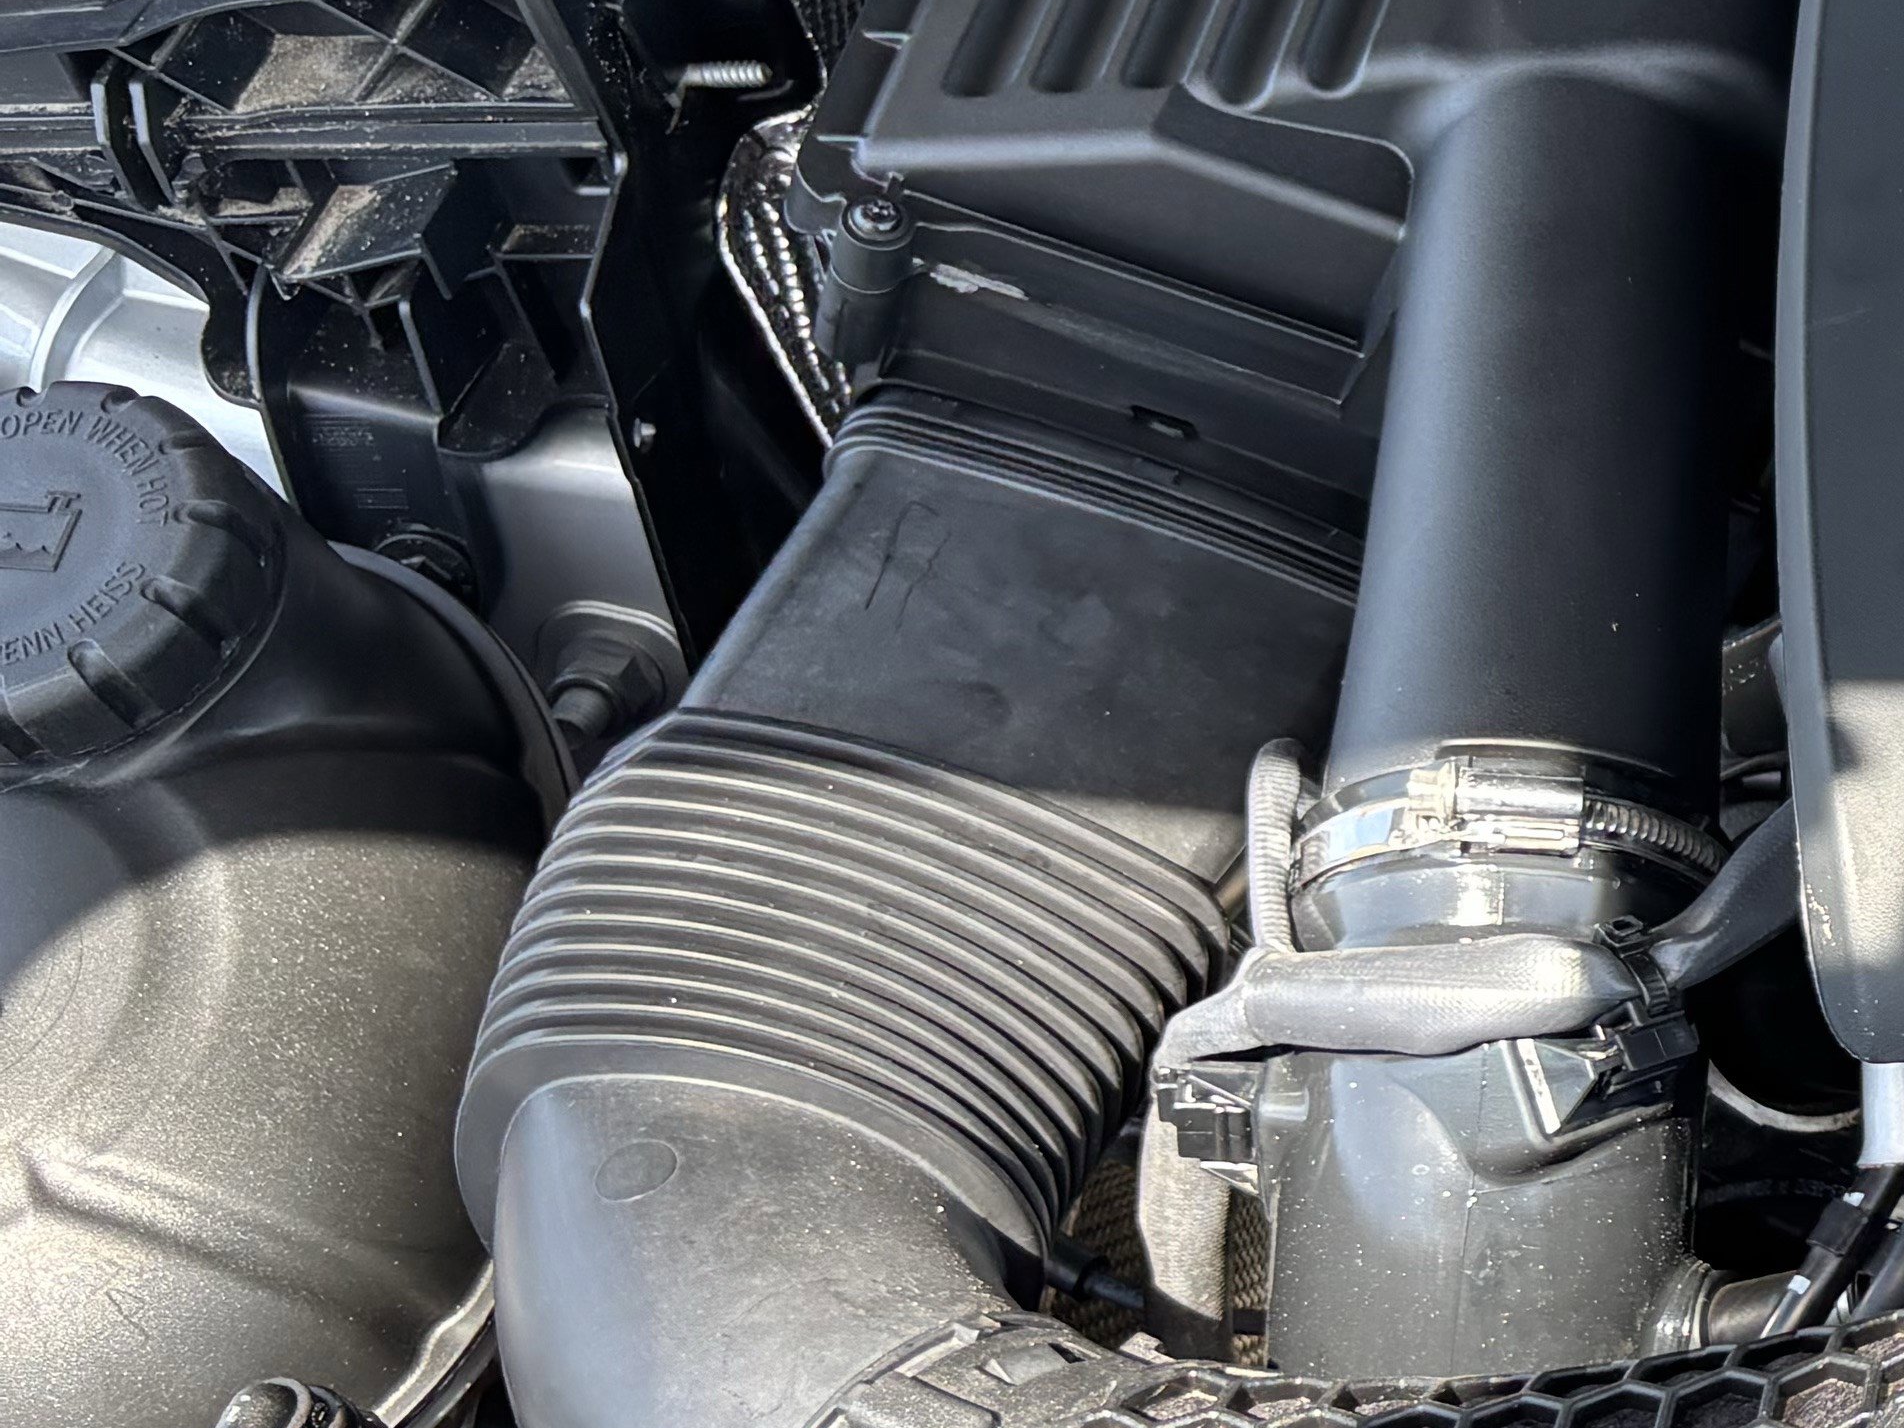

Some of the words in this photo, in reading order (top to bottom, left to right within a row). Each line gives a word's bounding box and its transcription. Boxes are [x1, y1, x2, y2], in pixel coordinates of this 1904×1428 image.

[0, 409, 84, 439] OPEN
[85, 417, 161, 477] WHEN
[137, 474, 170, 527] HOT
[0, 621, 65, 666] ENN
[68, 561, 146, 634] HEISS
